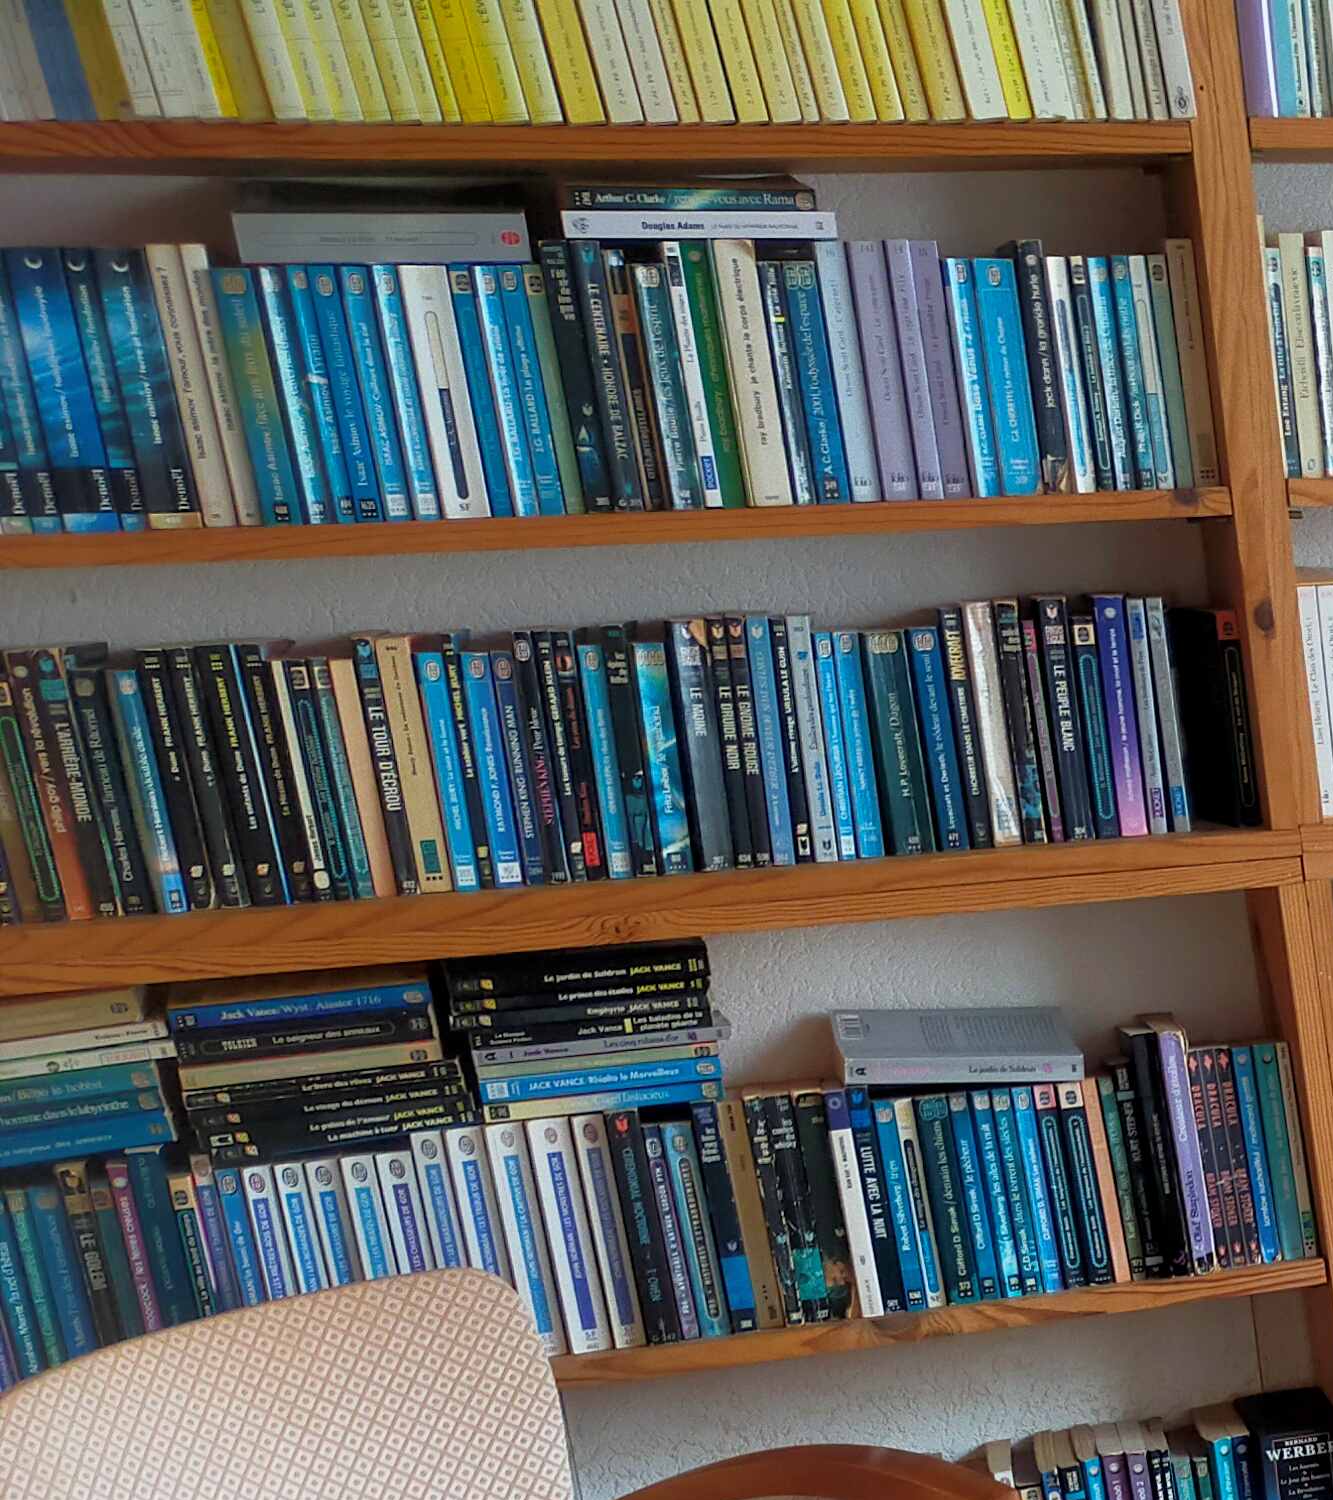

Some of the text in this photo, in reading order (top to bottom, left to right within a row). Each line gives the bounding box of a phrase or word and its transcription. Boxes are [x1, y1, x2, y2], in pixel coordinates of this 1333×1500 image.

[642, 222, 704, 231] Douglas Adams
[505, 706, 518, 726] MAN
[371, 726, 391, 756] TOUR
[654, 963, 681, 972] VANCE
[859, 1146, 877, 1173] LUTTE
[864, 1177, 881, 1199] AVEC
[871, 1218, 887, 1238] NUIT
